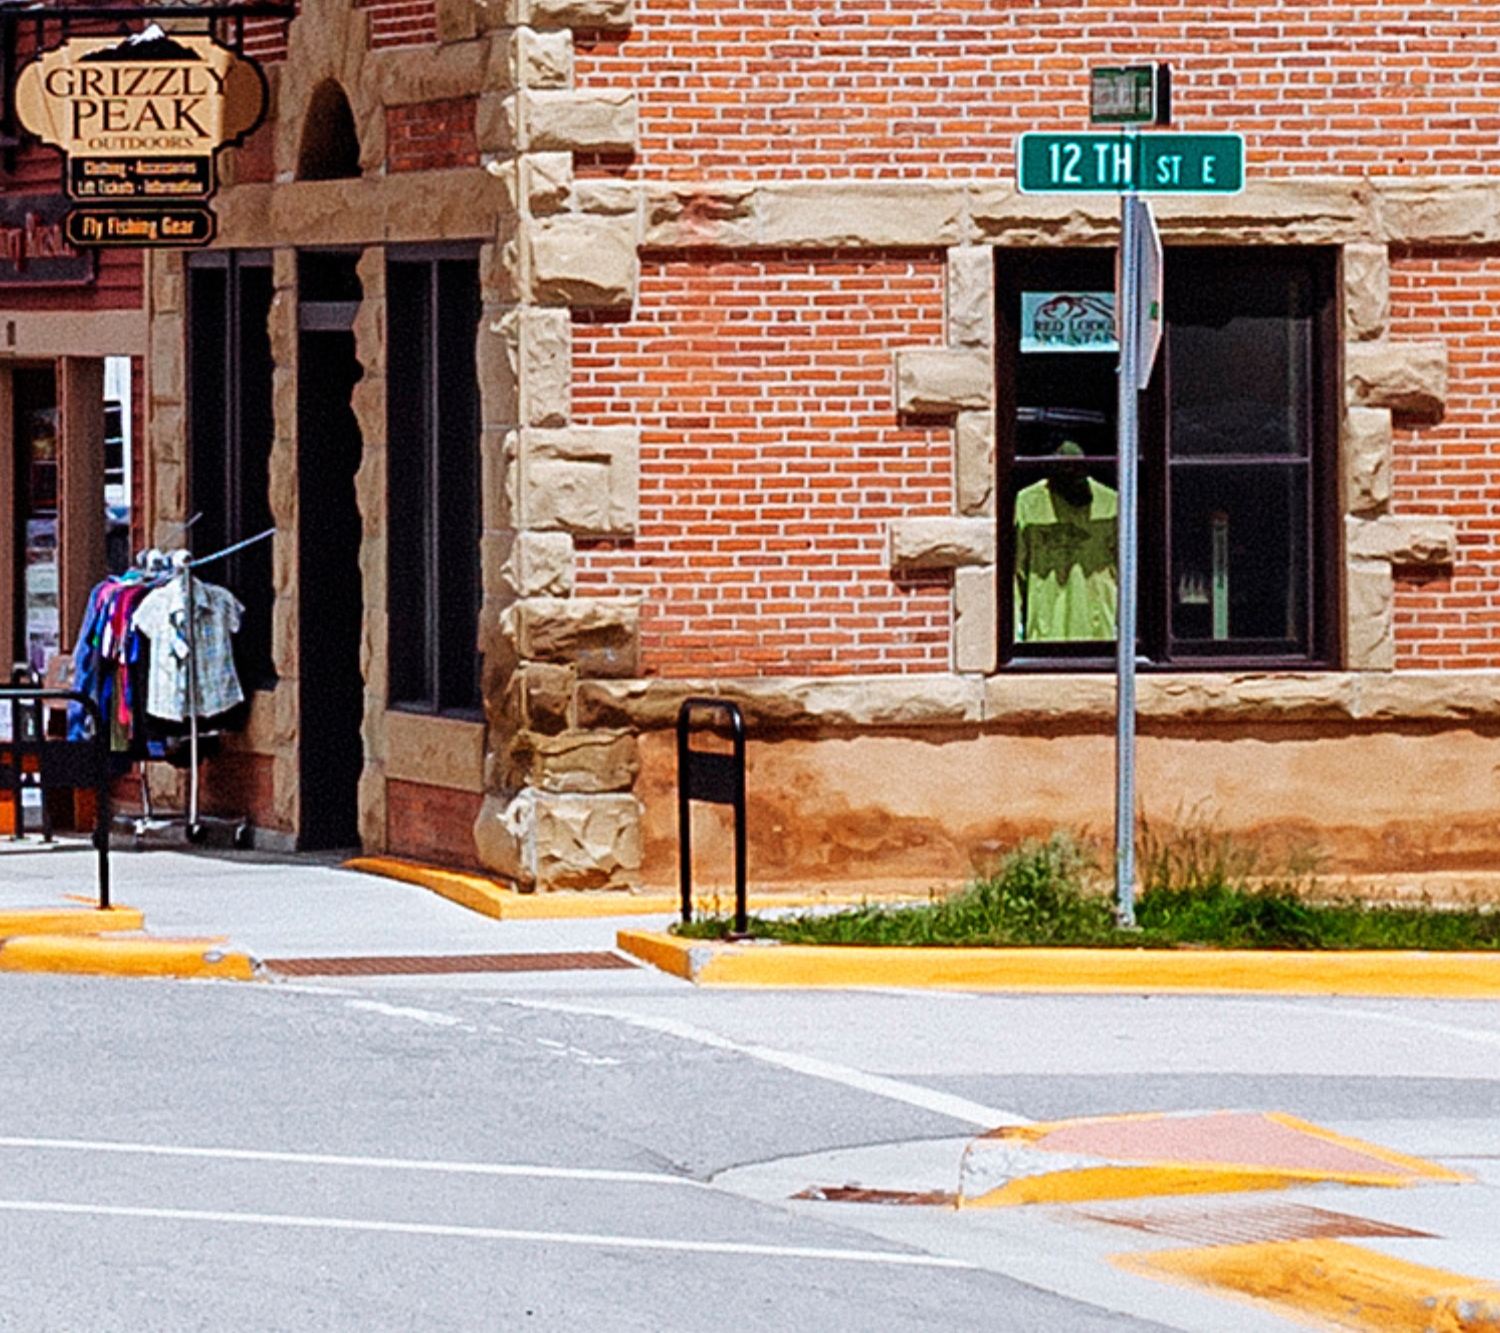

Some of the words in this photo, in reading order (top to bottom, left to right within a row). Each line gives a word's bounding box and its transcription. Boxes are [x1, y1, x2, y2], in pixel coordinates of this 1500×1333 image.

[45, 67, 234, 97] GRIZZLY
[71, 98, 211, 140] PEAK
[88, 137, 195, 149] OUTDOORS
[1049, 143, 1082, 182] 12
[1093, 143, 1132, 182] TH
[1157, 156, 1182, 183] ST
[1202, 156, 1216, 183] E
[83, 217, 103, 240] Fly
[108, 217, 157, 240] Fishing
[162, 217, 195, 235] Gear
[1034, 320, 1064, 331] RED
